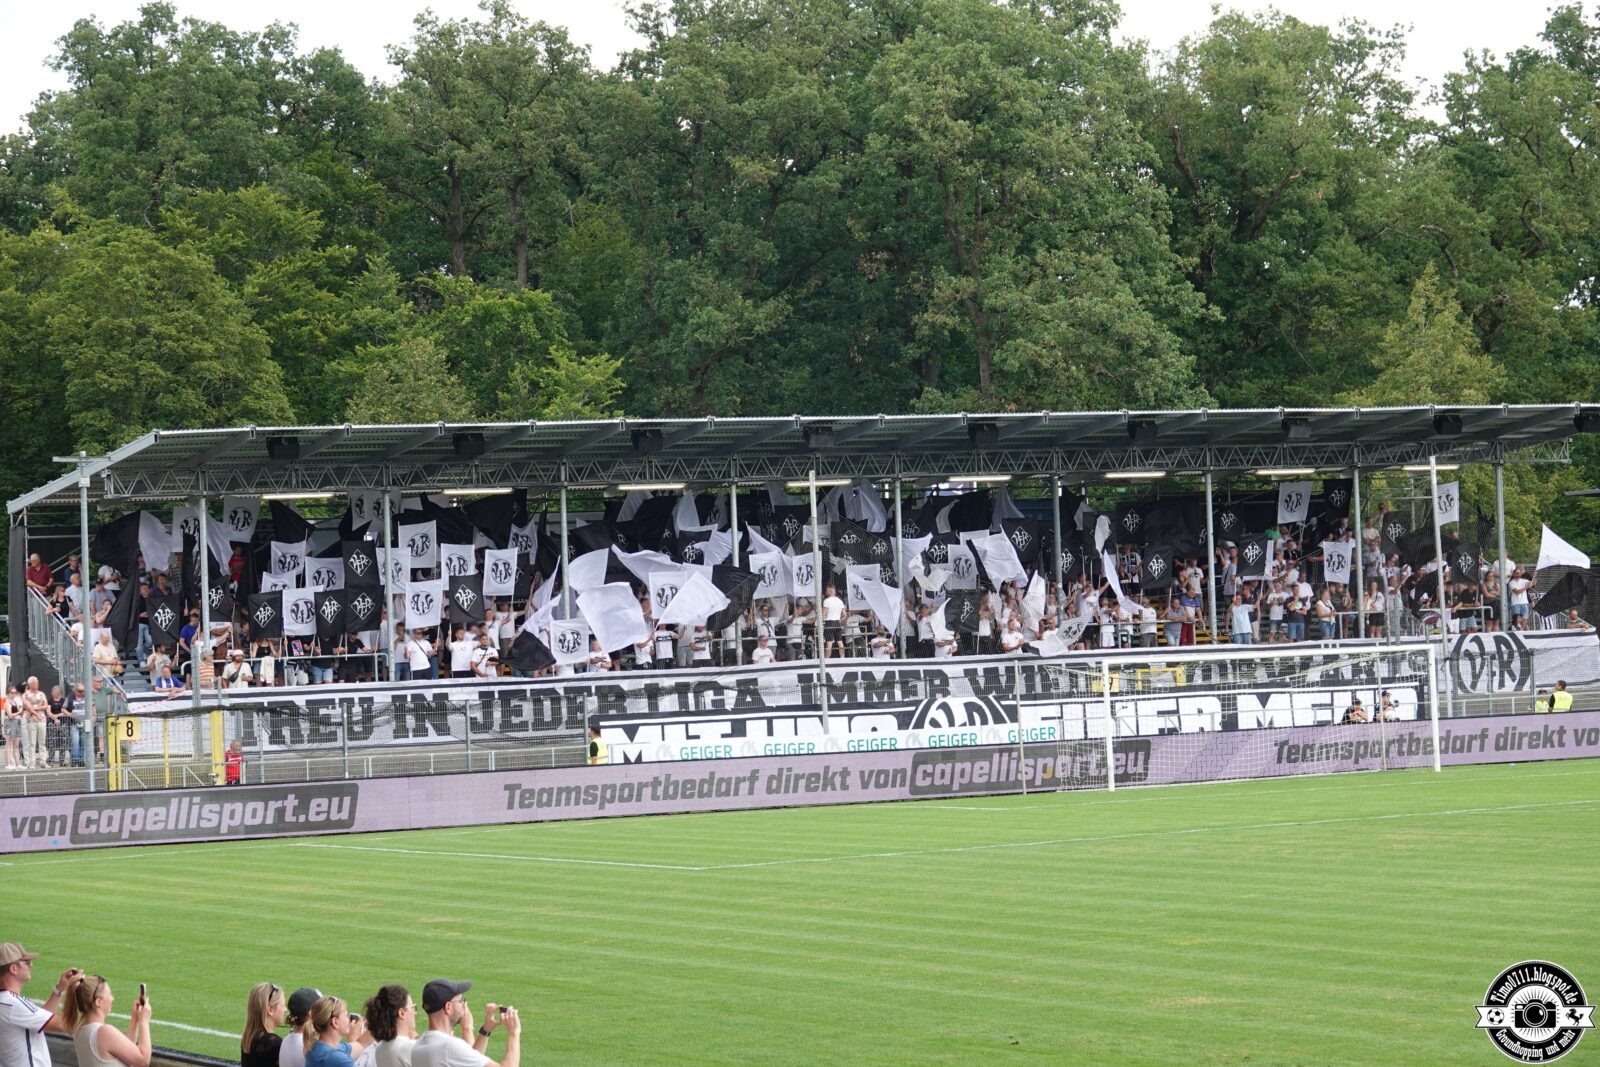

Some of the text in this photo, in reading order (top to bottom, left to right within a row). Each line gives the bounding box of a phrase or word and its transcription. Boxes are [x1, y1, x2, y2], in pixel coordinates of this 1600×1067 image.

[229, 509, 252, 530] VfR
[407, 534, 430, 556] VfR
[278, 554, 300, 572] VfR
[446, 555, 469, 577] VfR
[492, 561, 512, 583] VfR
[1327, 552, 1345, 571] VfR
[313, 568, 336, 589] VfR
[291, 600, 315, 623] VfR
[559, 632, 581, 652] VfR
[1464, 634, 1517, 692] VfR
[230, 696, 373, 746] TREU
[391, 692, 451, 739] IN
[469, 684, 628, 735] JEDER
[797, 669, 951, 705] IMMER
[126, 720, 134, 737] 8
[1008, 726, 1056, 743] GEIGER
[764, 742, 816, 756] GEIGER
[847, 737, 898, 752] GEIGER
[928, 732, 978, 747] GEIGER
[1274, 723, 1600, 766] Teamsportbedarf direkt vo
[680, 745, 732, 760] GEIGER
[504, 749, 1146, 811] Teamsportbedarf direkt von capellisport.eu
[10, 794, 352, 839] von capellisport.eu
